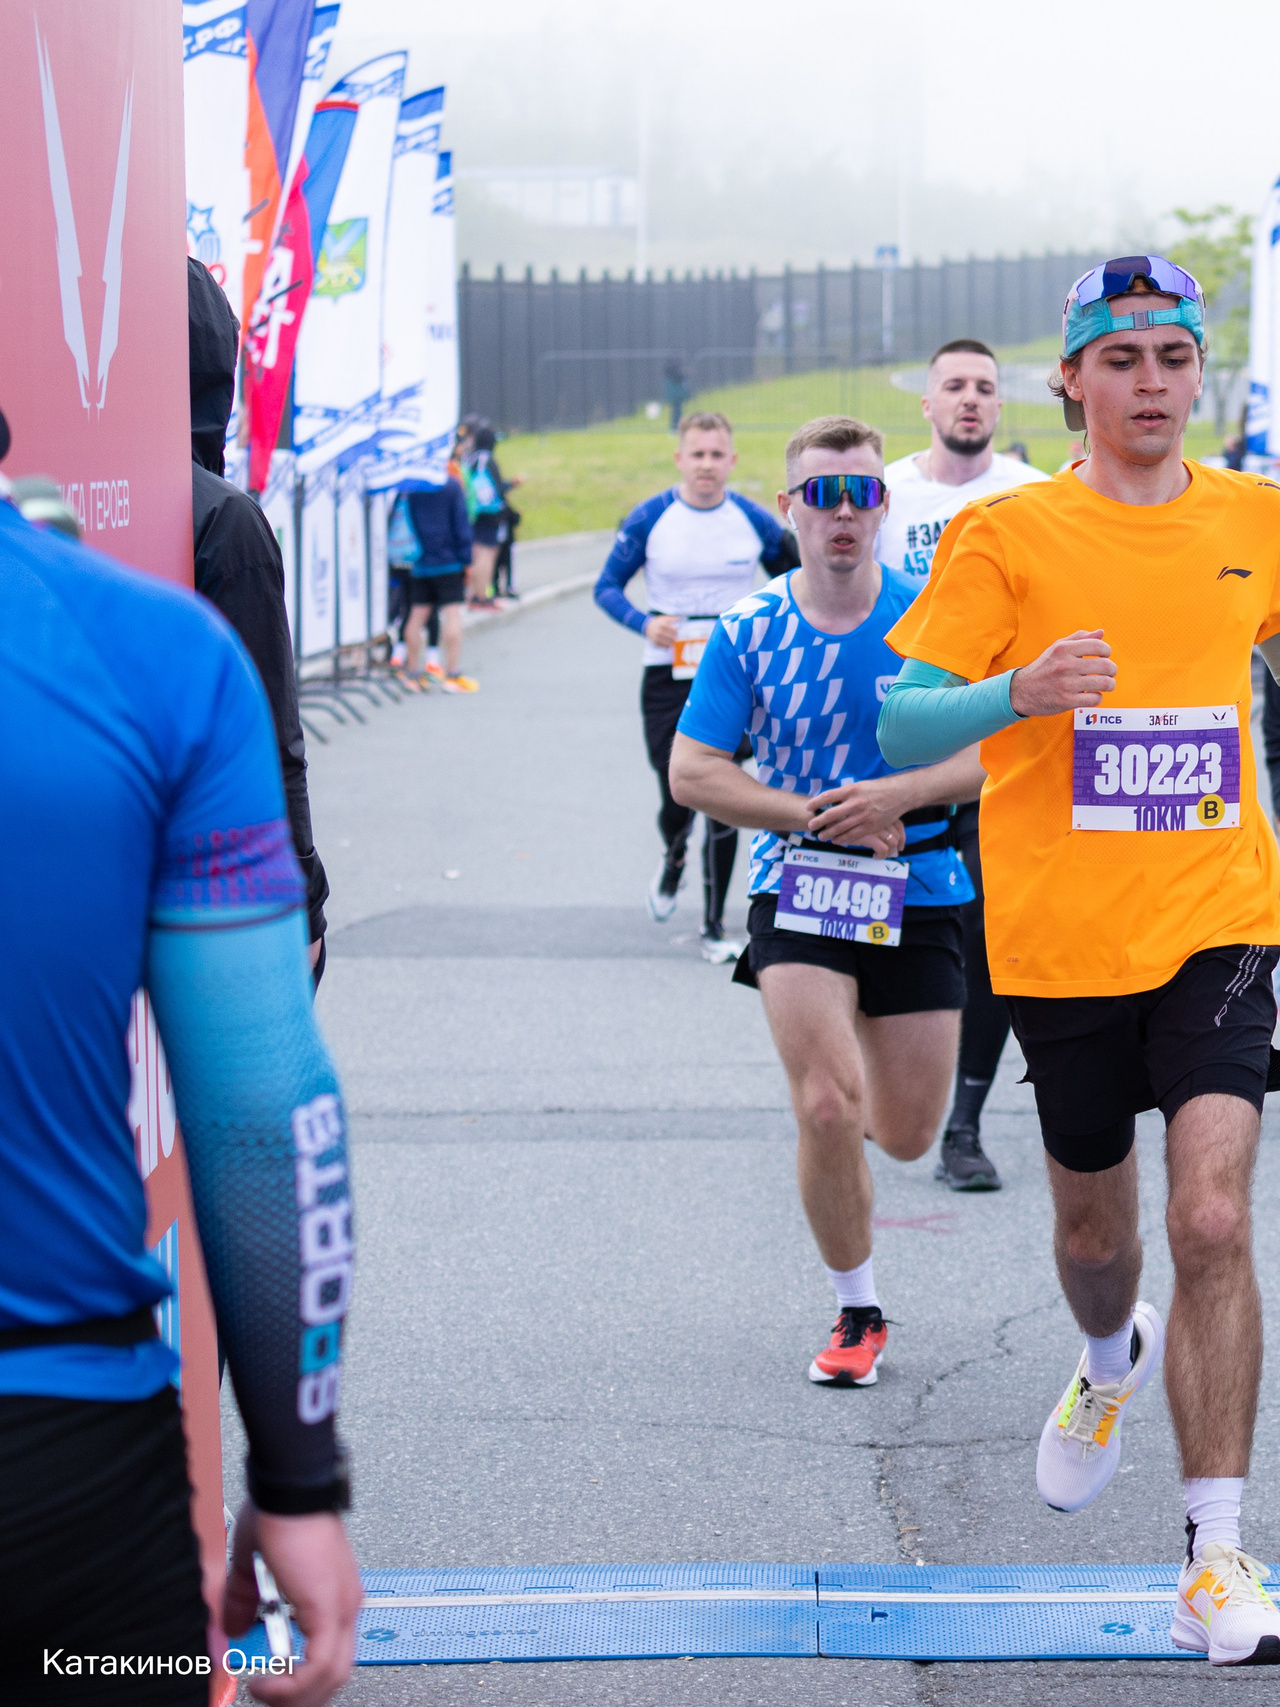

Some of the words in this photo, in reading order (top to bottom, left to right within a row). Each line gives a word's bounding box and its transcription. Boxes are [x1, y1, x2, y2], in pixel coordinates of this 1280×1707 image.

[89, 480, 130, 532] ГЕРОЕВ
[1100, 715, 1122, 724] ПСБ
[1094, 742, 1222, 796] 30223
[803, 855, 819, 864] ПСБ
[792, 874, 892, 920] 30498
